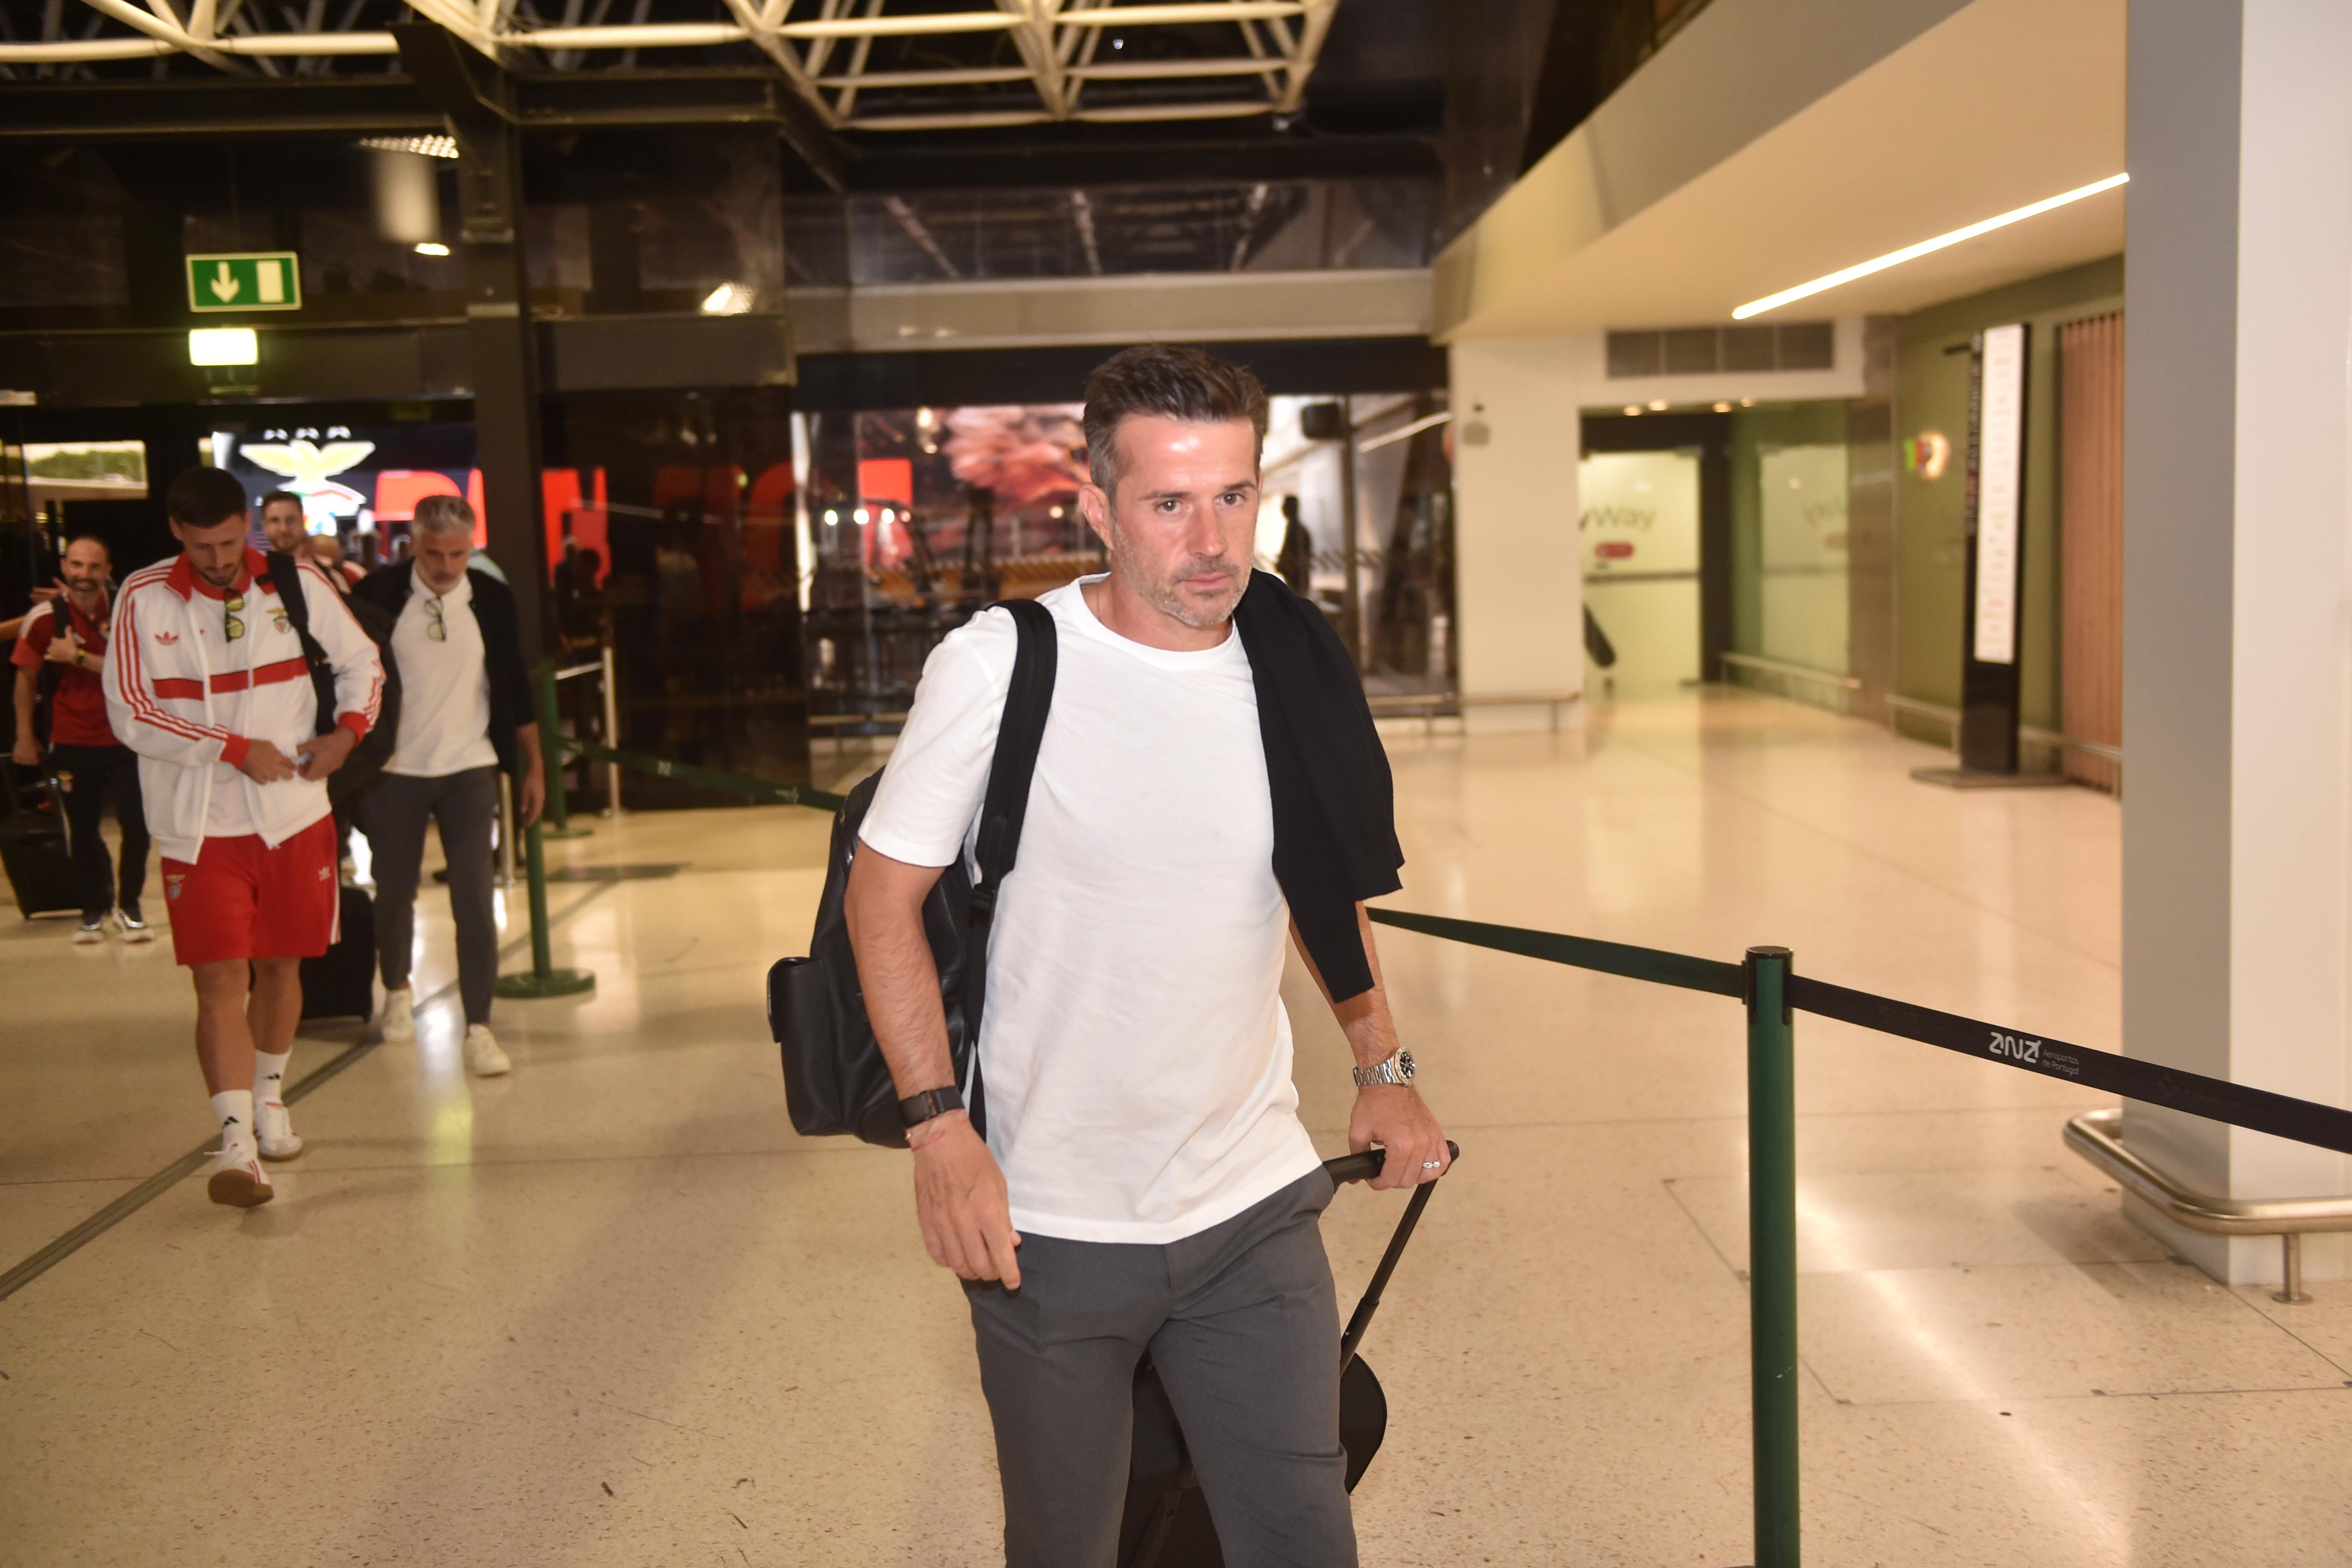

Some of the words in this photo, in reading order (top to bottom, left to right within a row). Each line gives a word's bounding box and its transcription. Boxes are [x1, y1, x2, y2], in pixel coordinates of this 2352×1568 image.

[2043, 1049, 2079, 1065] Aeroportos
[2042, 1059, 2051, 1068] de
[2052, 1061, 2079, 1076] Portugal
